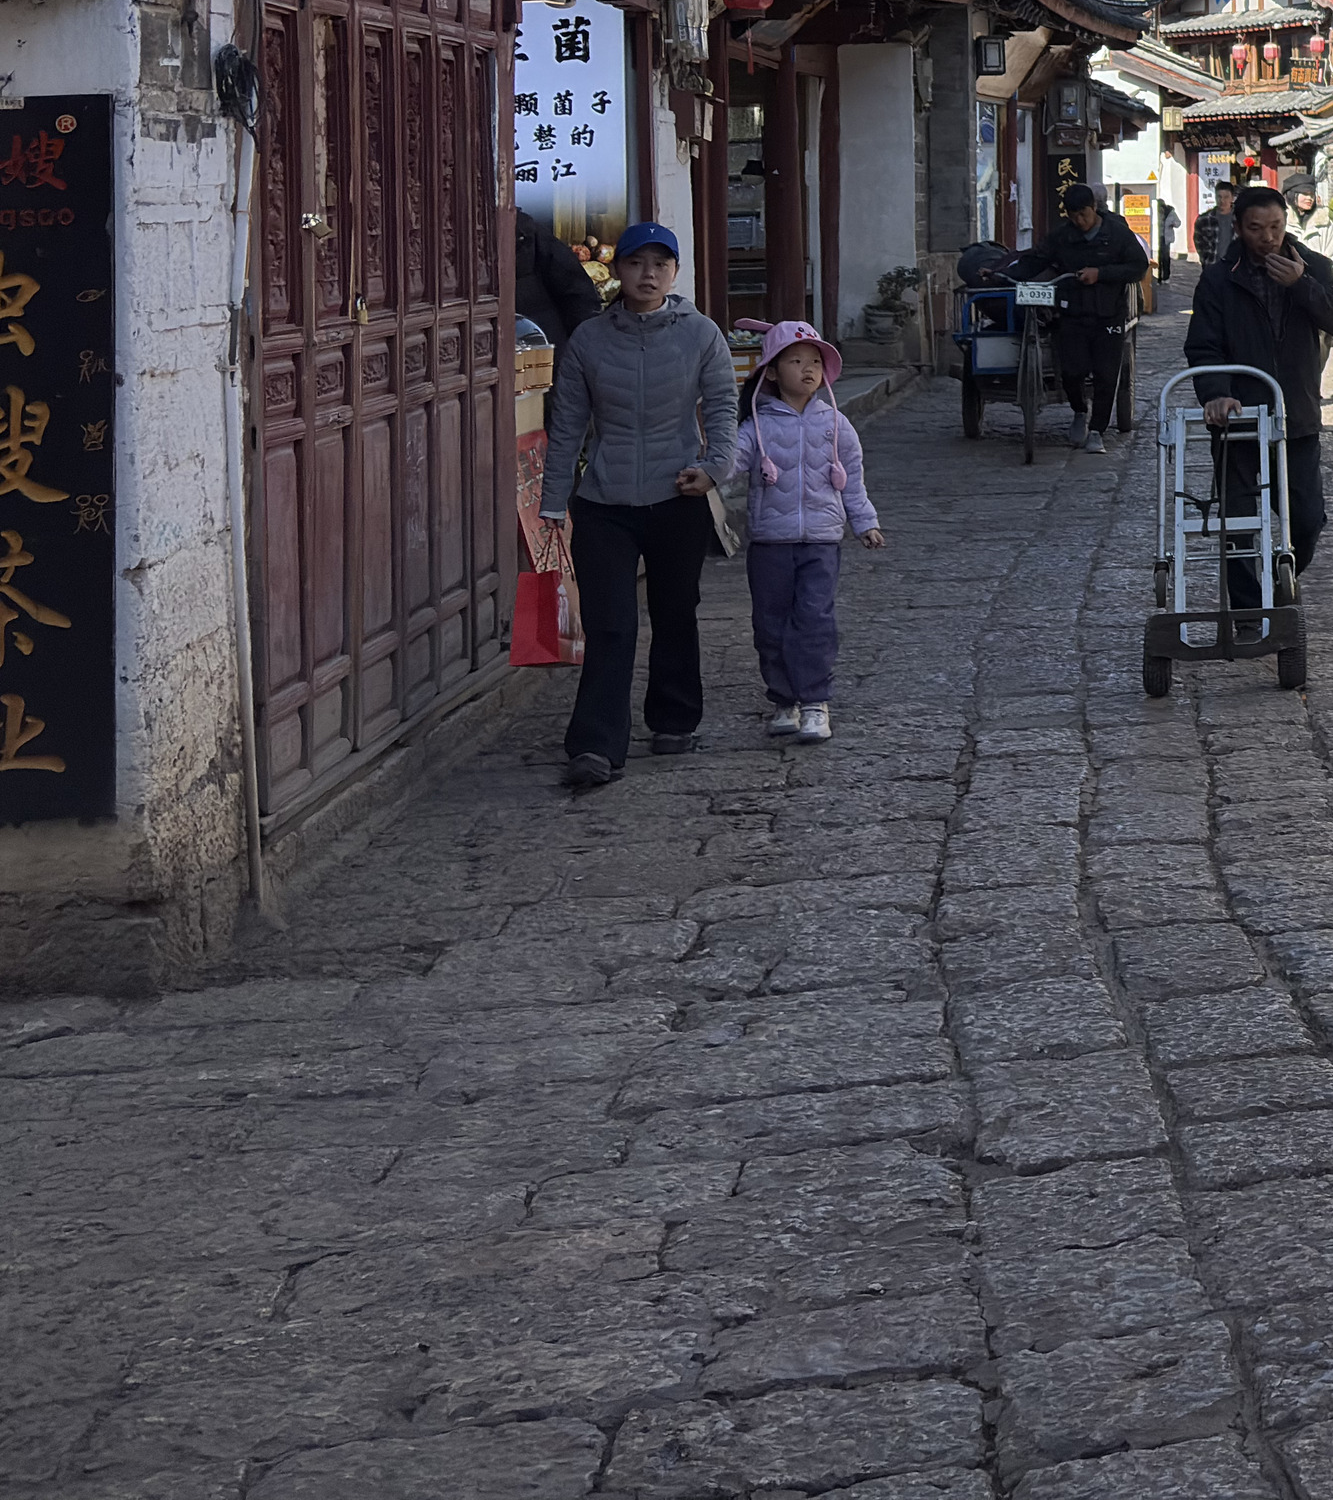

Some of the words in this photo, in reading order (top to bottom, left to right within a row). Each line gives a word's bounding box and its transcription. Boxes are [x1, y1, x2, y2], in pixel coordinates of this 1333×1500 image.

[515, 123, 595, 151] 整的
[515, 158, 577, 183] 丽江
[1106, 325, 1122, 335] Y-3
